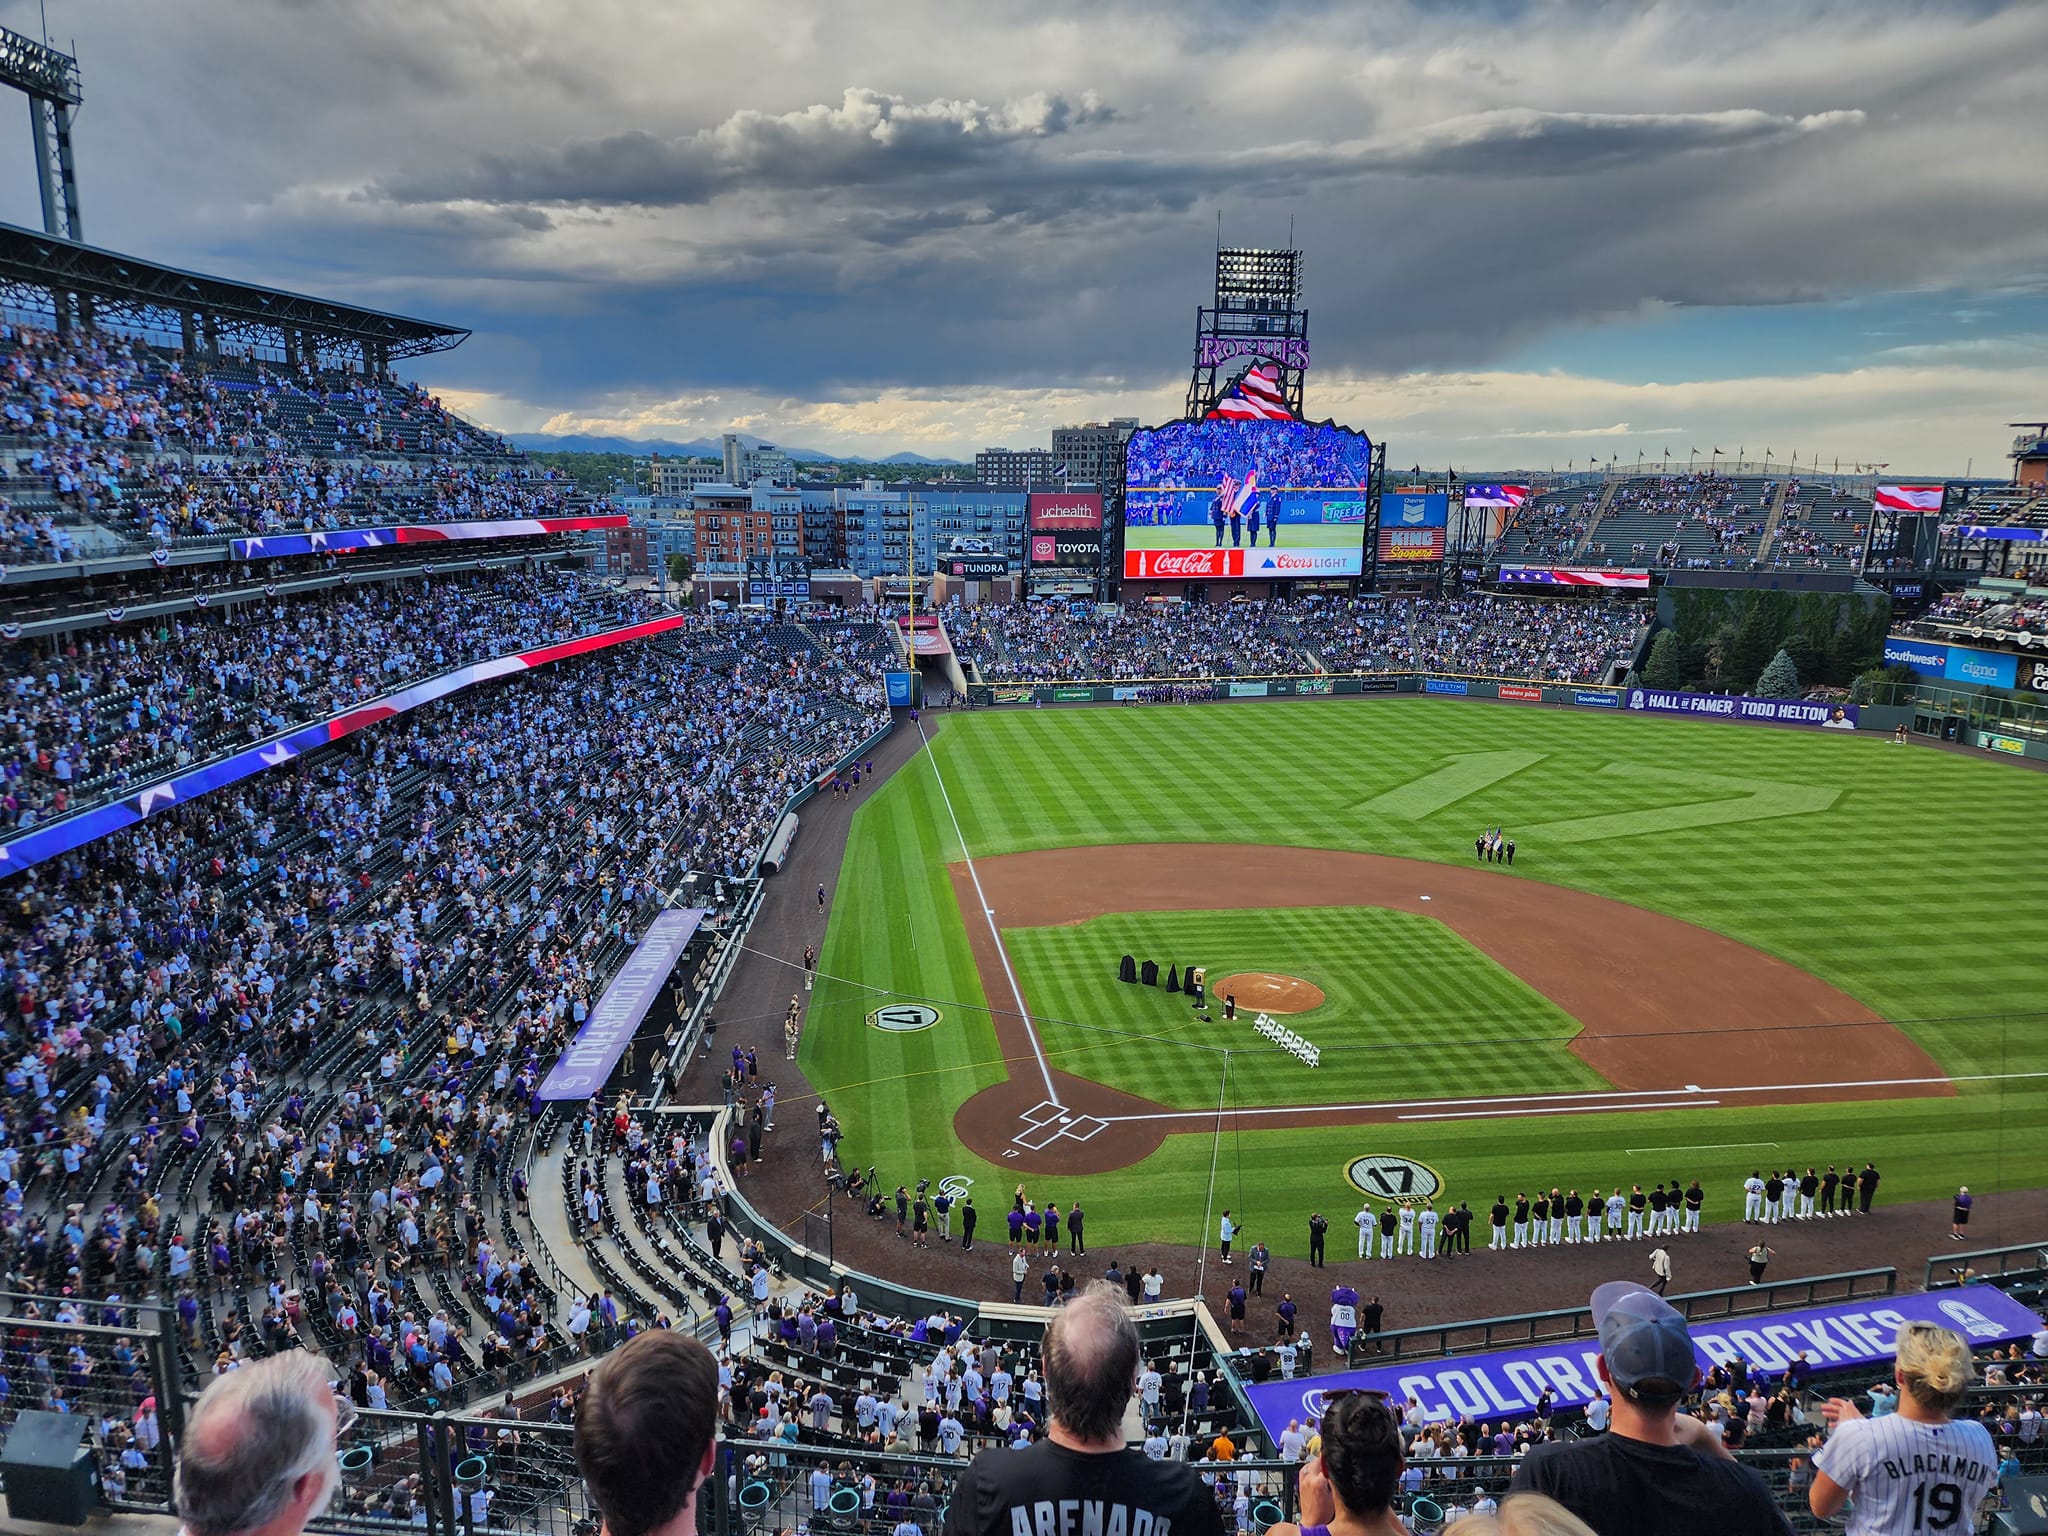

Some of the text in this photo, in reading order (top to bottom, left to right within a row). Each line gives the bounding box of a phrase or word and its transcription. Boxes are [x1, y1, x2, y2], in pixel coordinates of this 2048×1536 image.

[1199, 337, 1310, 369] ROCKIES
[1041, 504, 1092, 517] uchealth
[1290, 508, 1305, 516] 390
[1391, 531, 1433, 546] KING
[1056, 543, 1100, 553] TOYOTA
[1390, 545, 1433, 560] Soopers
[964, 563, 1005, 573] TUNDRA
[1153, 552, 1213, 574] Coca-Cola
[1278, 553, 1348, 569] Coors LIGHT
[1884, 648, 1938, 666] Southwest
[1961, 661, 1998, 678] cigna
[1577, 695, 1612, 705] Southwest
[1648, 694, 1679, 709] HALL
[1690, 698, 1734, 714] FAMER
[1741, 700, 1776, 717] TODD
[1777, 704, 1829, 722] HELTON
[607, 926, 684, 971] WELCOME
[618, 973, 655, 987] TO
[591, 990, 644, 1029] COORS
[882, 1010, 922, 1024] 17
[565, 1031, 619, 1068] FIELD
[1002, 1149, 1020, 1158] 17
[1366, 1166, 1414, 1194] 17
[1340, 1312, 1350, 1320] 00
[1692, 1309, 1905, 1374] ROCKIES
[998, 1382, 1006, 1390] 17
[1147, 1381, 1157, 1390] 25
[816, 1402, 826, 1411] 17
[861, 1407, 869, 1415] 21
[945, 1430, 955, 1439] 30
[1153, 1449, 1161, 1458] 19
[1884, 1453, 1990, 1486] BLACKMON
[1913, 1481, 1962, 1530] 19
